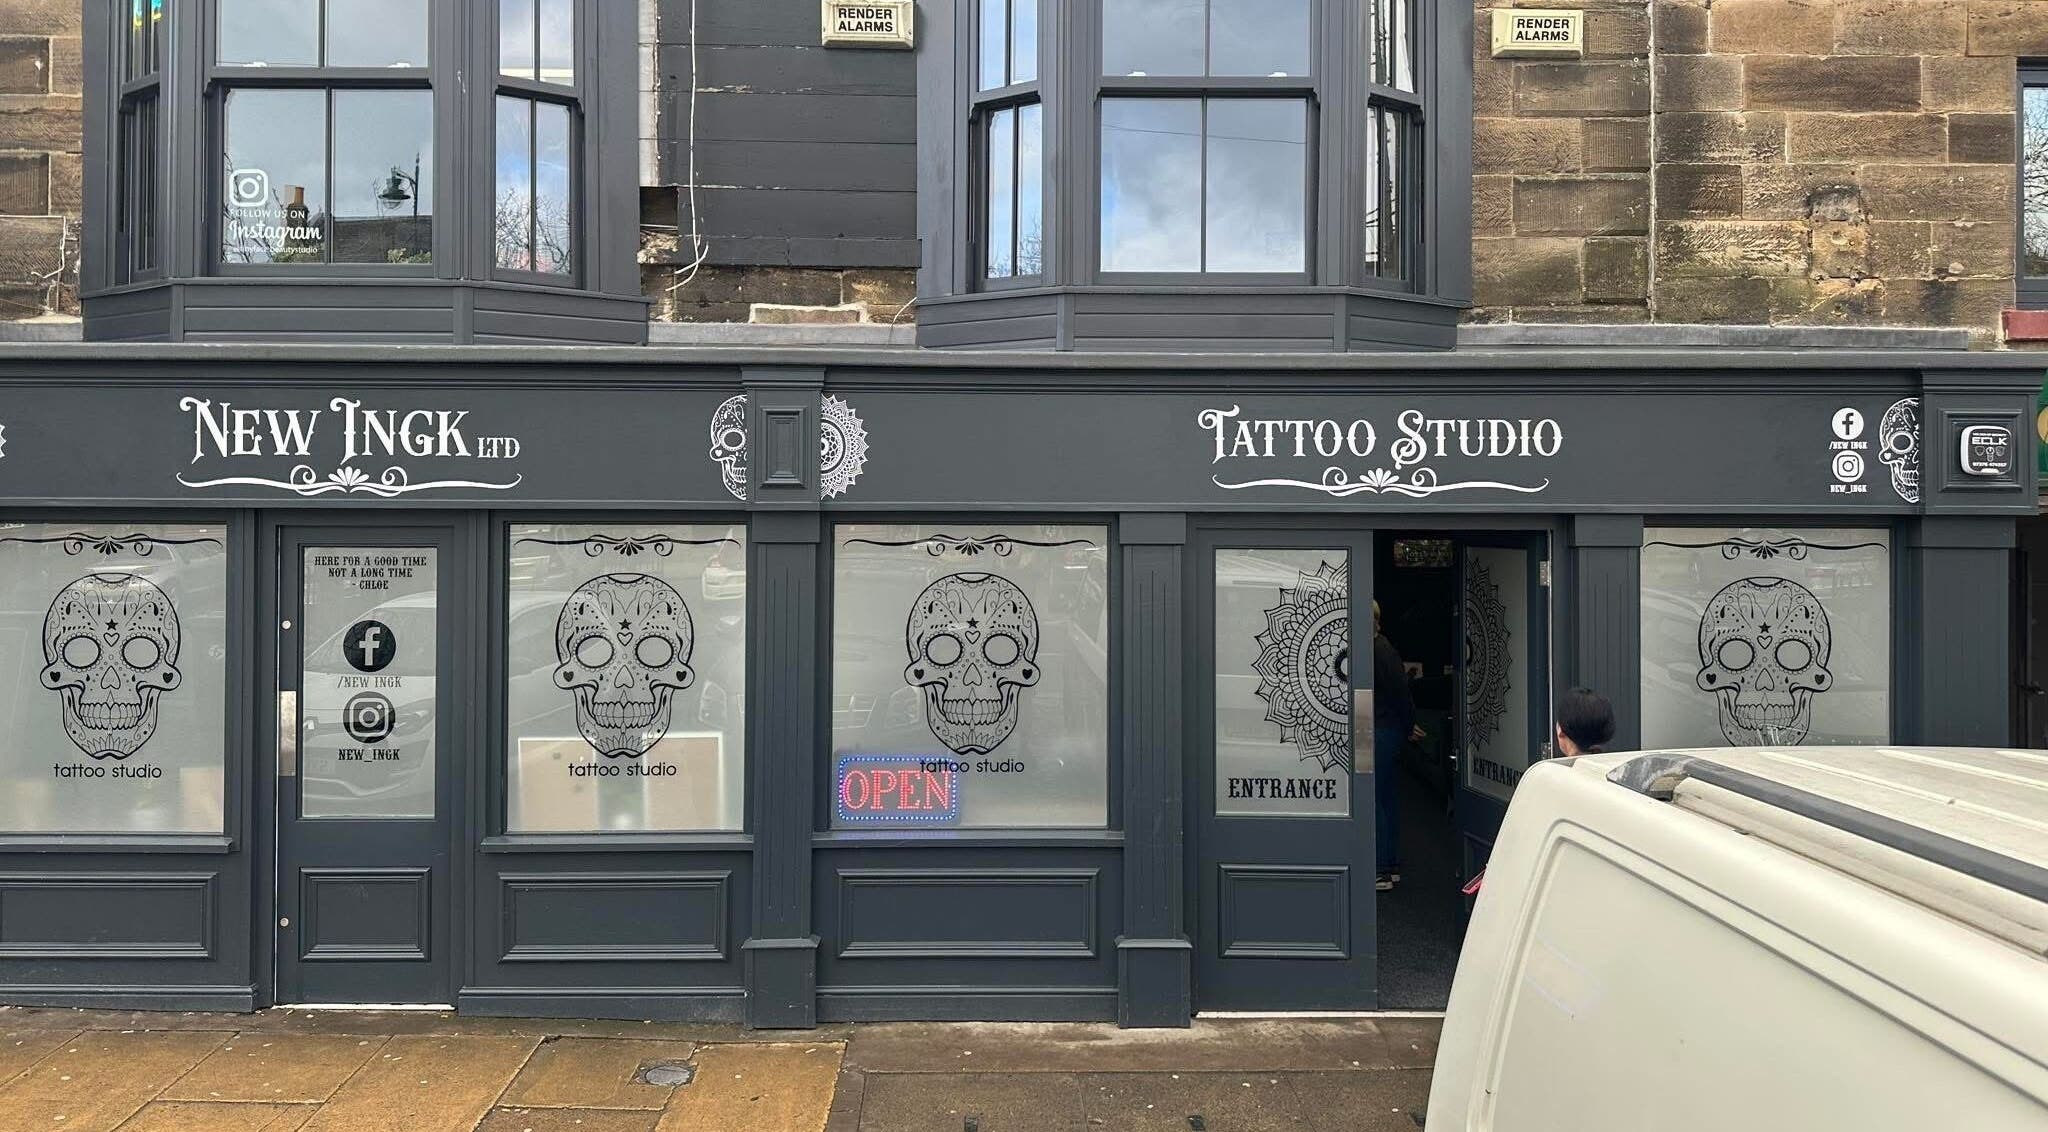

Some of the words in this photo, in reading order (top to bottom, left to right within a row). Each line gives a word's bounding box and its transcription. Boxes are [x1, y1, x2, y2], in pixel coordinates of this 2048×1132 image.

[838, 8, 893, 19] RENDER
[838, 21, 893, 32] ALARMS
[1516, 18, 1570, 29] RENDER
[1515, 31, 1569, 41] ALARMS
[230, 209, 271, 218] FOLLOW
[274, 209, 287, 218] US
[290, 210, 305, 219] ON
[229, 220, 322, 247] Instagram
[180, 396, 322, 464] NEW
[330, 397, 472, 465] INGK
[477, 437, 521, 459] LTD
[1198, 404, 1377, 464] TATTOO
[1390, 409, 1564, 470] STUDIO
[314, 556, 339, 566] HERE
[343, 557, 360, 566] FOR
[364, 557, 371, 566] A
[374, 557, 398, 566] GOOD
[402, 557, 427, 566] TIME
[328, 568, 347, 577] NOT
[350, 568, 357, 577] A
[361, 568, 384, 577] LONG
[388, 568, 413, 578] TIME
[359, 580, 389, 590] CHLOE
[337, 676, 369, 689] /NEW
[375, 676, 402, 688] INGK
[338, 748, 401, 762] NEW_INGK
[53, 763, 105, 778] tattoo
[112, 763, 162, 778] studio
[568, 762, 620, 776] tattoo
[626, 762, 677, 776] studio
[919, 759, 969, 773] tattoo
[976, 759, 1025, 773] studio
[1472, 756, 1522, 788] ENTRANC
[842, 769, 951, 810] OPEN
[1227, 777, 1337, 799] ENTRANCE
